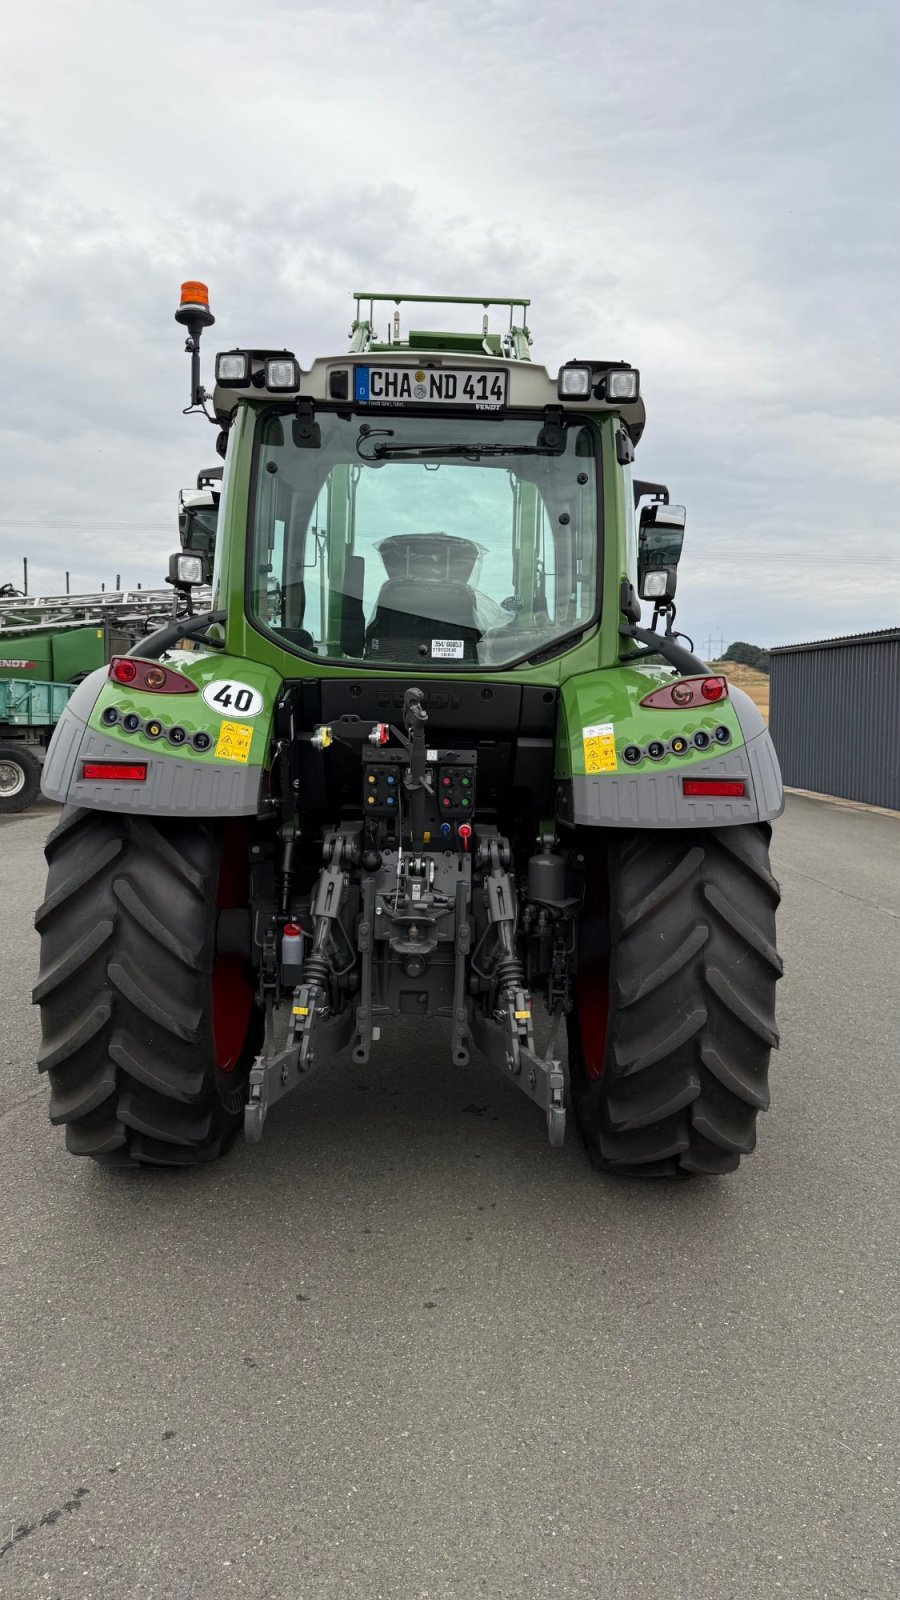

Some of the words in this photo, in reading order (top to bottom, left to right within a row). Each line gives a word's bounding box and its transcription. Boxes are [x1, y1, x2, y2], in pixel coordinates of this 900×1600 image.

[359, 387, 366, 395] D
[370, 371, 412, 398] CHA
[429, 373, 458, 399] ND
[463, 374, 503, 400] 414
[213, 684, 254, 712] 40
